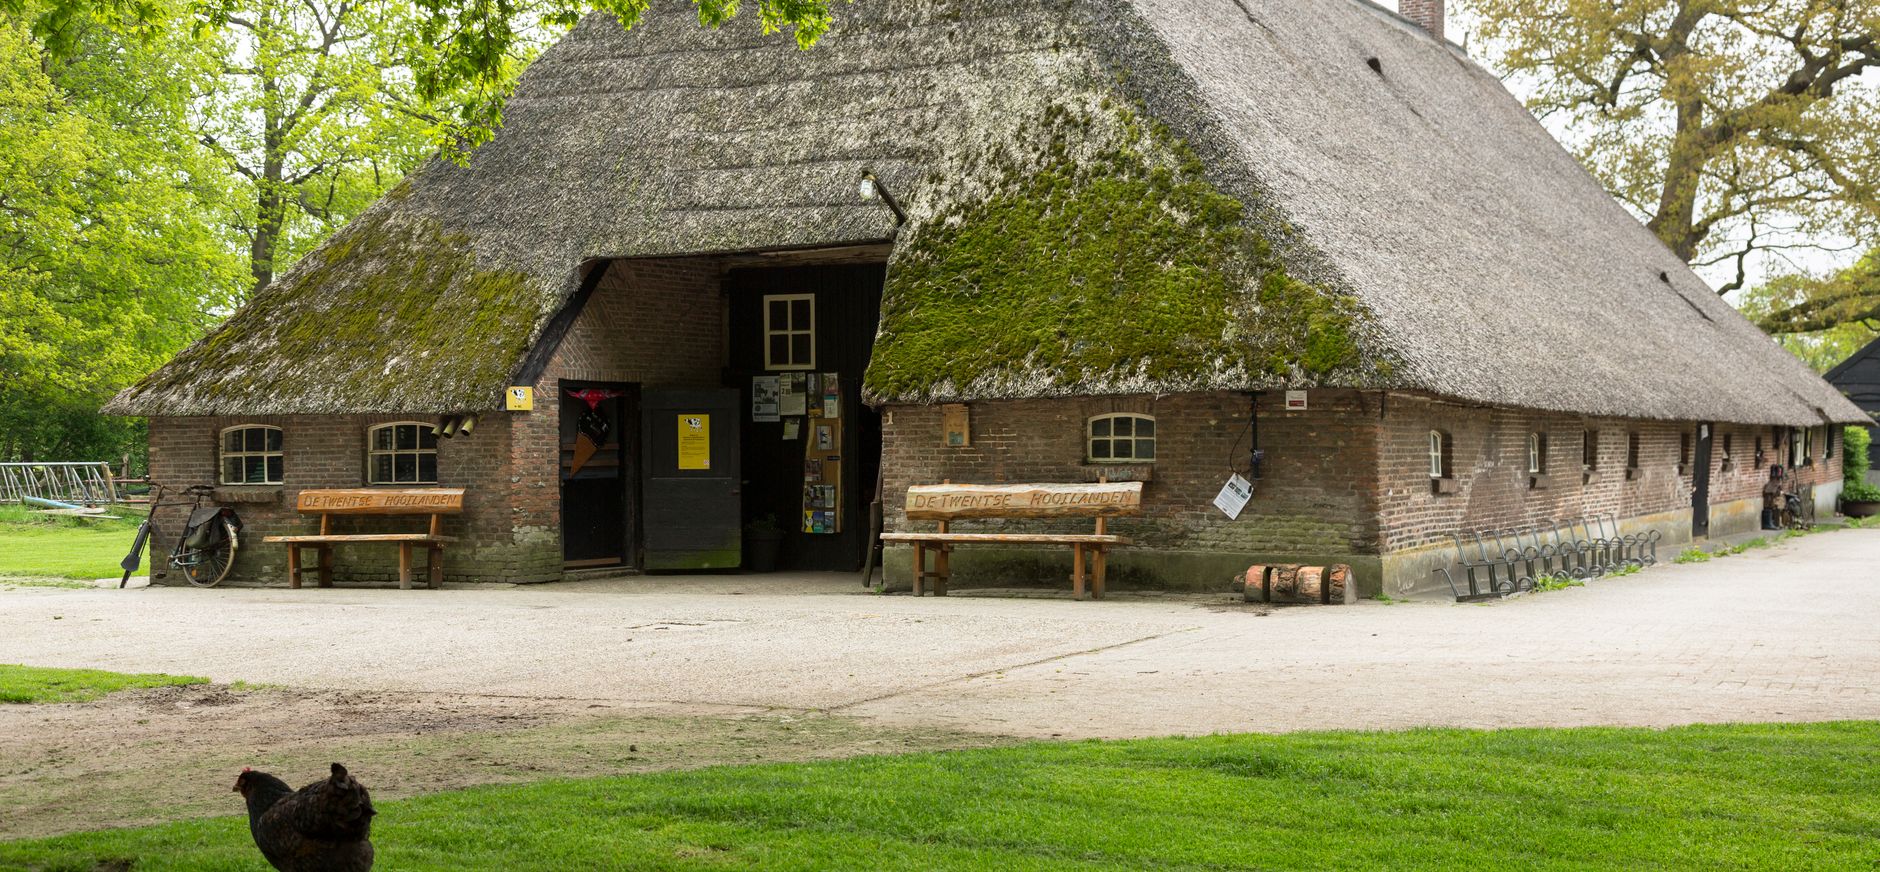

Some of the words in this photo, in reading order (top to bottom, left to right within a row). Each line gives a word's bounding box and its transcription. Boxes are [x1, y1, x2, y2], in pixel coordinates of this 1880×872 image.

[886, 410, 894, 425] 1
[303, 495, 319, 507] DE
[322, 495, 374, 507] TWENTSE
[384, 494, 457, 506] HOOILANDEN
[914, 494, 937, 508] DE
[939, 493, 1013, 508] TWENTSE
[1029, 489, 1134, 506] HOOILANDEN
